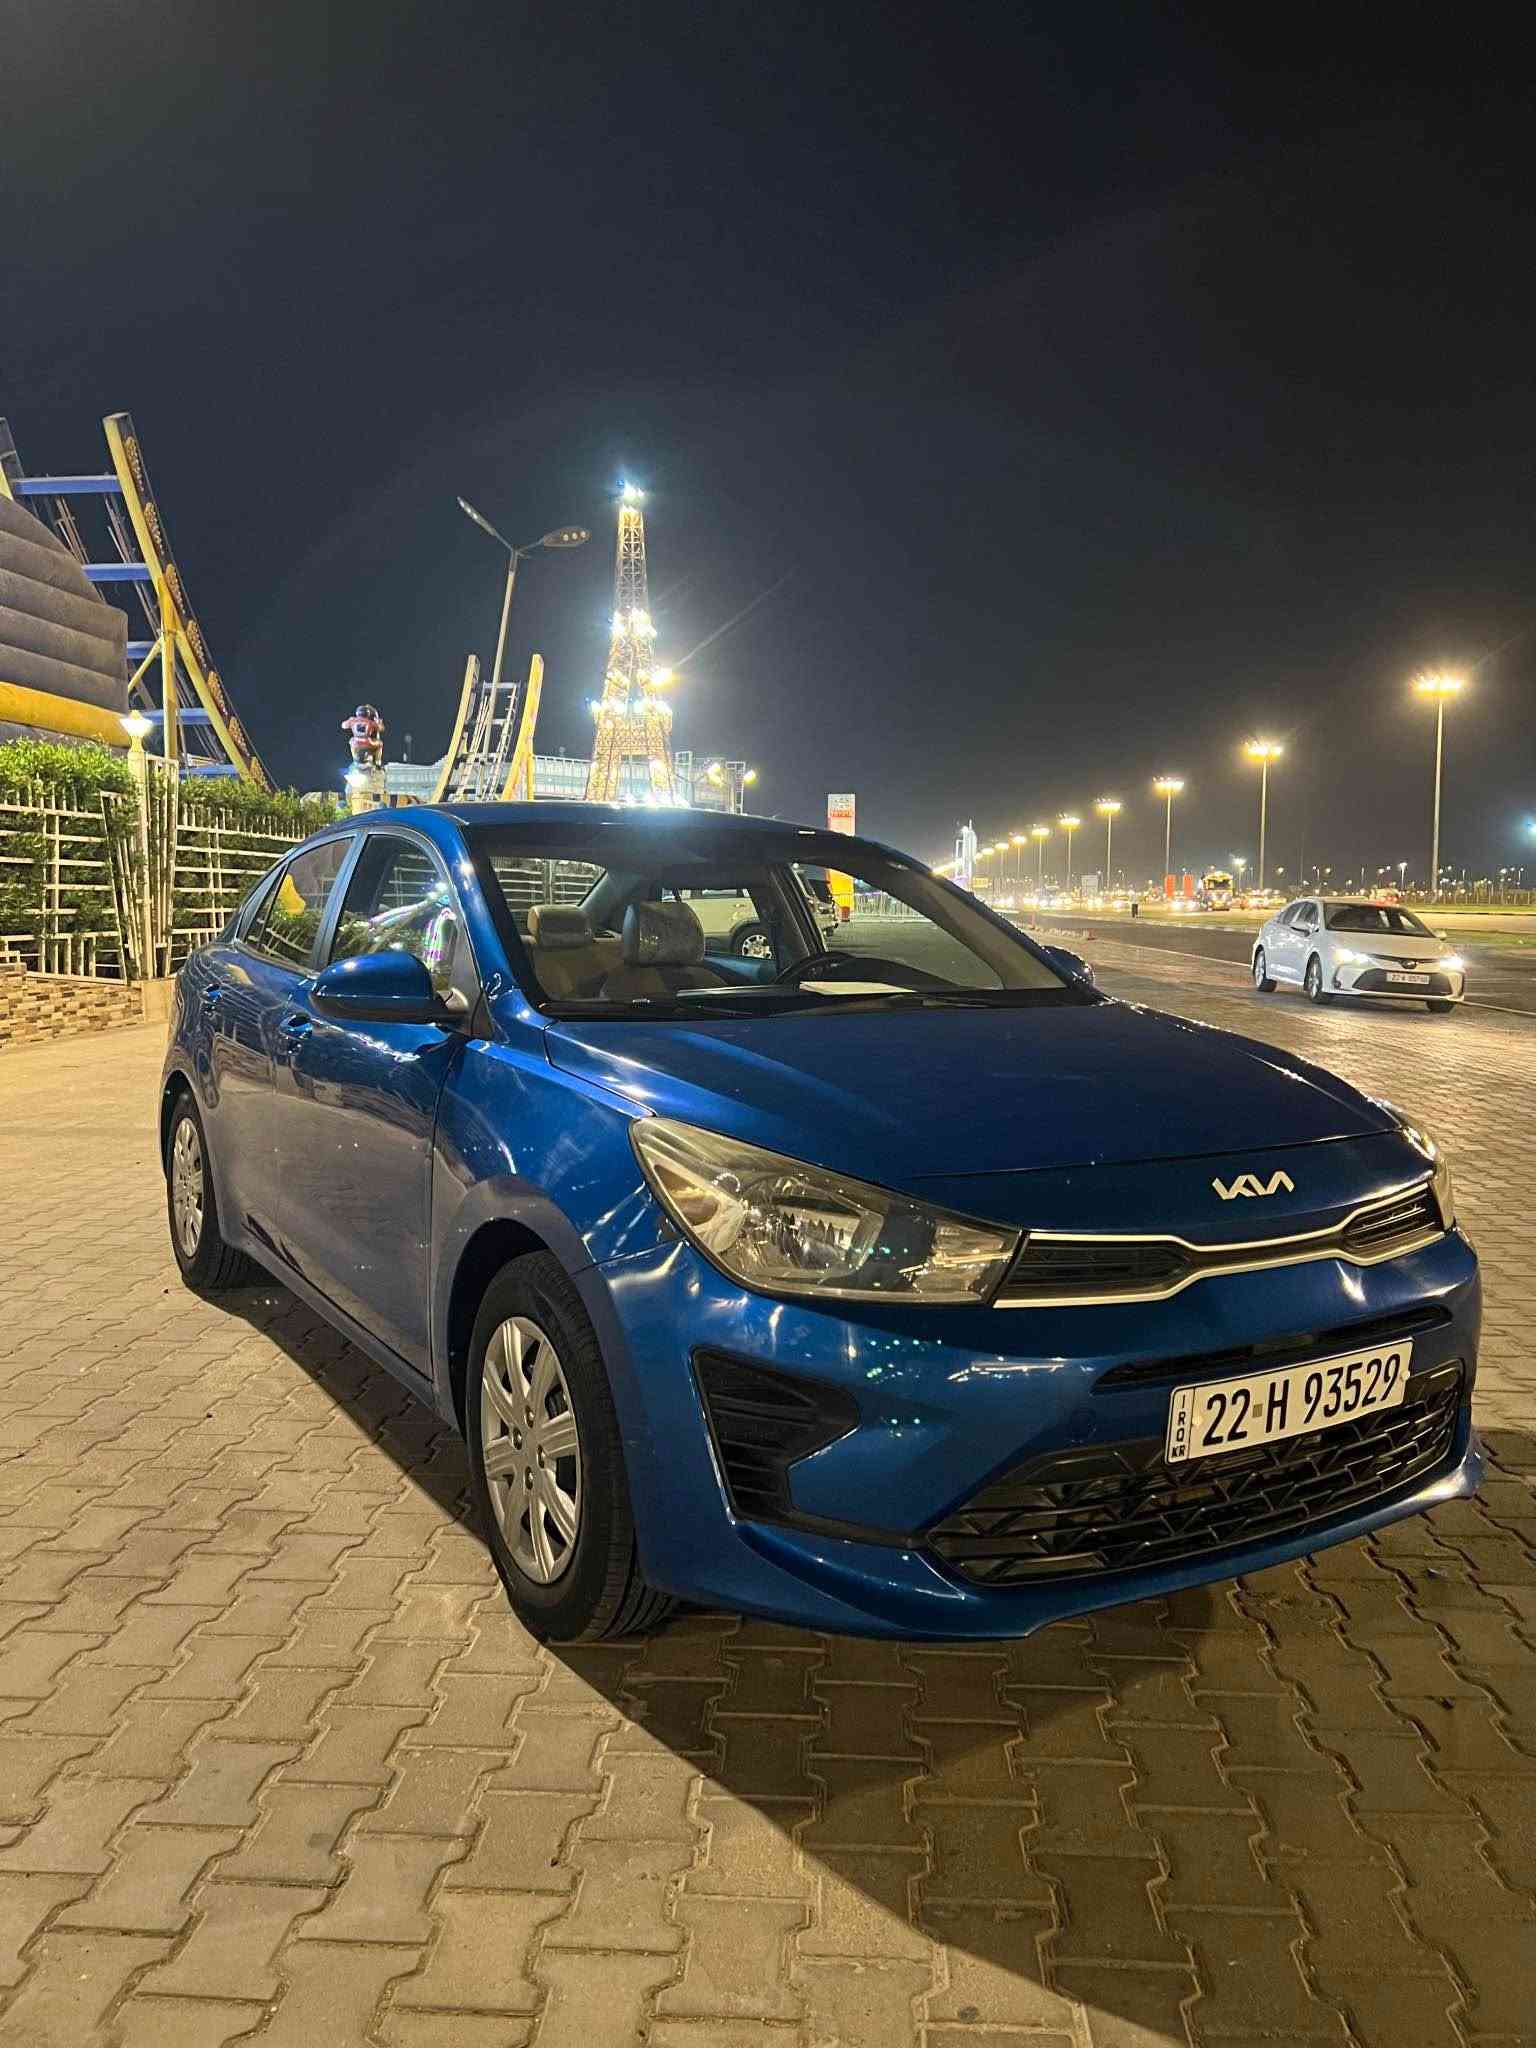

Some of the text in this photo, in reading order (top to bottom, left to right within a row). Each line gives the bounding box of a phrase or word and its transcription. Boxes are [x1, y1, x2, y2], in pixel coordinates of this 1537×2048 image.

[1212, 1171, 1295, 1200] KIA
[1202, 1353, 1401, 1447] 22 H 93529
[1171, 1445, 1186, 1458] KR
